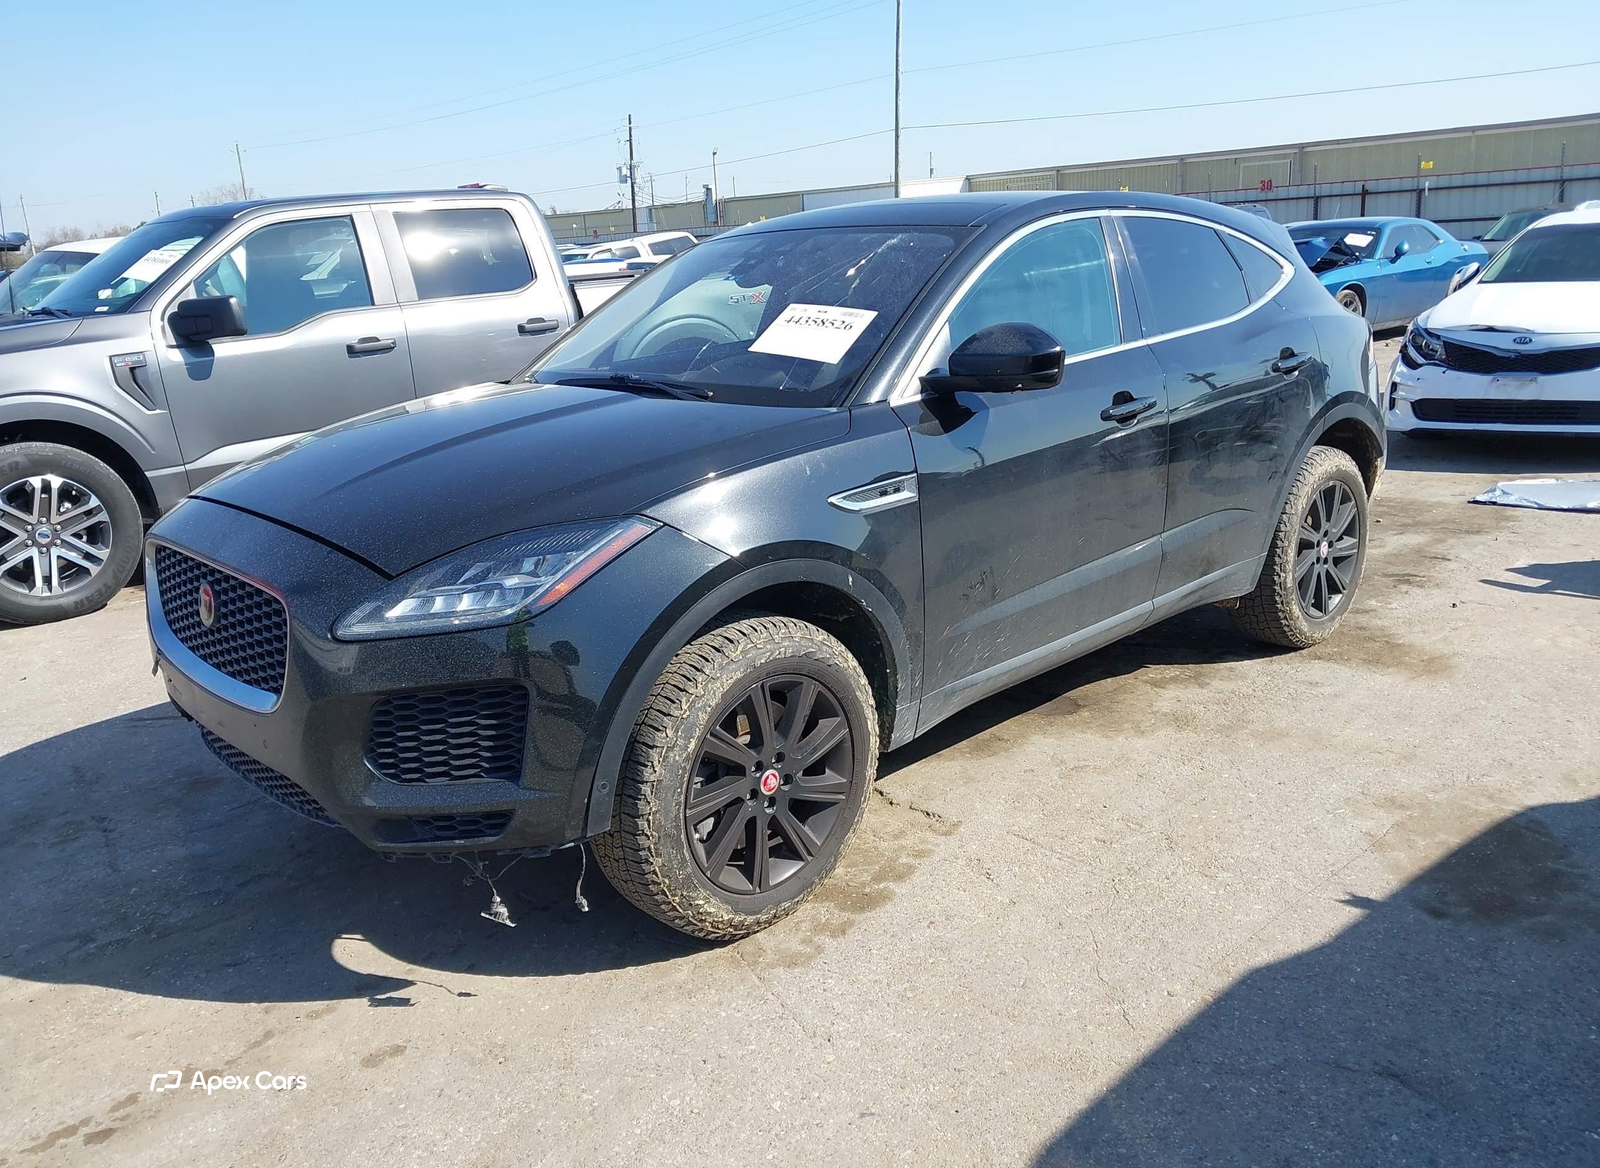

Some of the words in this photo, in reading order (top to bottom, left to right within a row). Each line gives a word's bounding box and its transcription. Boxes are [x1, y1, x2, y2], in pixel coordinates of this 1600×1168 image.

[1259, 179, 1273, 191] 30
[729, 291, 767, 305] STX
[784, 315, 854, 331] 44358526
[114, 355, 143, 363] F-150
